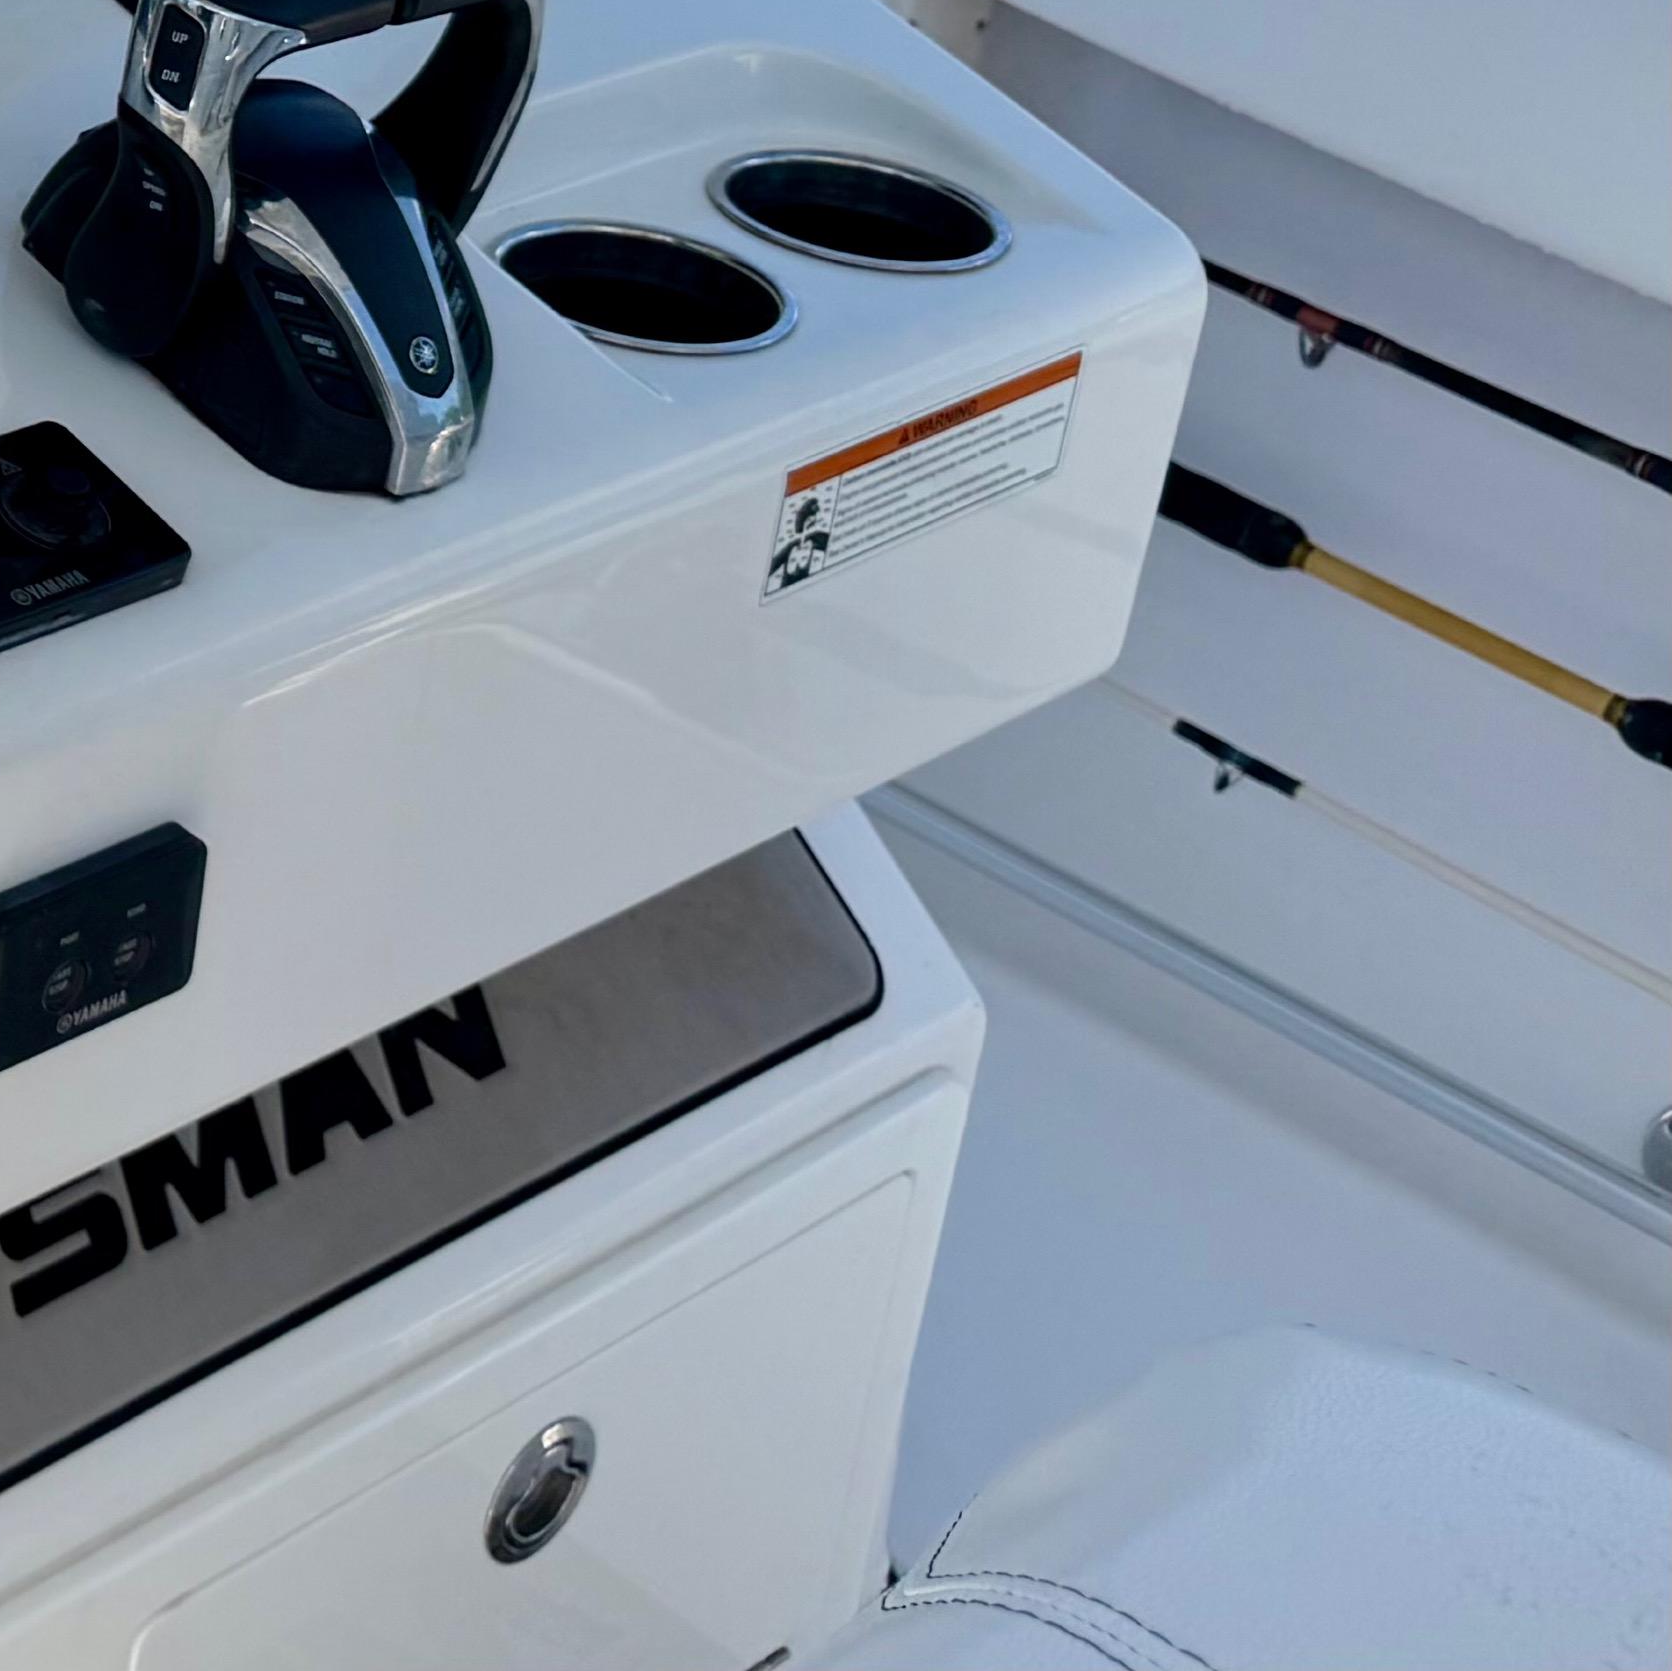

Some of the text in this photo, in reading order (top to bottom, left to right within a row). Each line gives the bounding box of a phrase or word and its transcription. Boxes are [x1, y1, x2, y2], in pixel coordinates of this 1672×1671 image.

[171, 30, 189, 44] UP
[161, 69, 180, 83] DN
[912, 400, 979, 438] WARNING
[24, 569, 91, 600] YAMAHA
[73, 989, 128, 1026] YAMAHA
